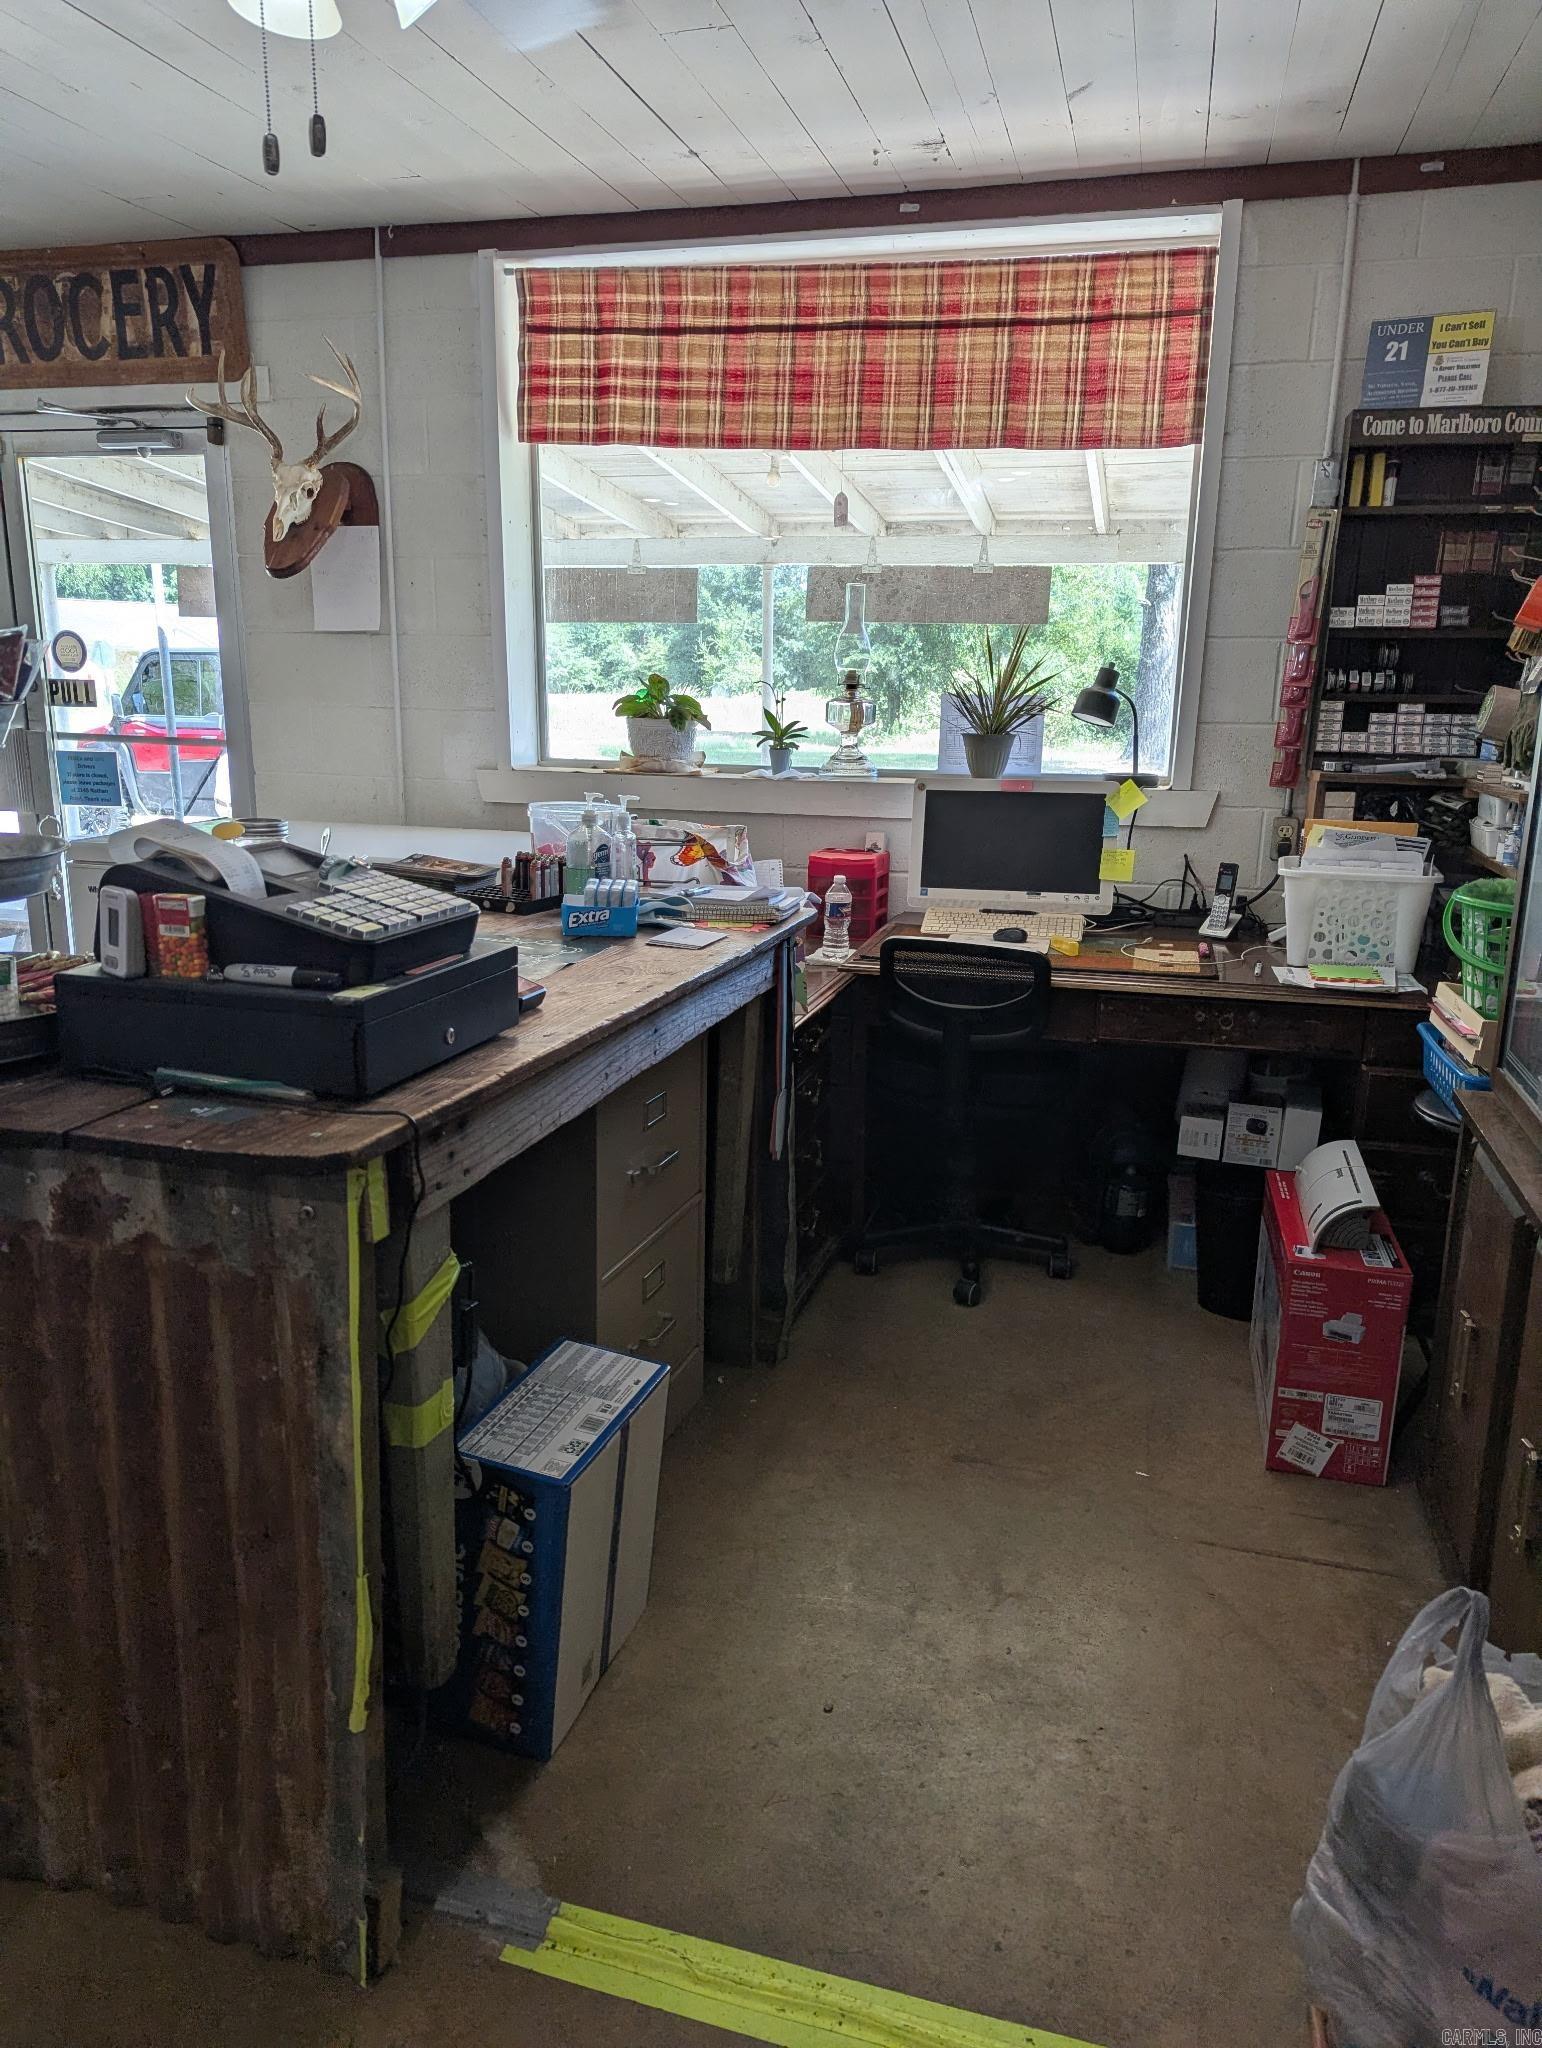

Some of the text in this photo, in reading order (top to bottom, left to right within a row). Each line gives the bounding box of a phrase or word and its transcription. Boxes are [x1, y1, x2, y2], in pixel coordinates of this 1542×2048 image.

[1378, 322, 1424, 336] UNDER
[1444, 321, 1468, 332] Can't
[1468, 320, 1486, 330] Sell
[1384, 340, 1408, 362] 21
[1432, 338, 1490, 350] You Can't Buy
[1362, 416, 1406, 436] Come
[1408, 416, 1424, 434] to
[1426, 413, 1502, 434] Marlboro
[49, 680, 94, 704] PULL
[568, 910, 610, 929] Extra
[1294, 1269, 1321, 1278] Canon
